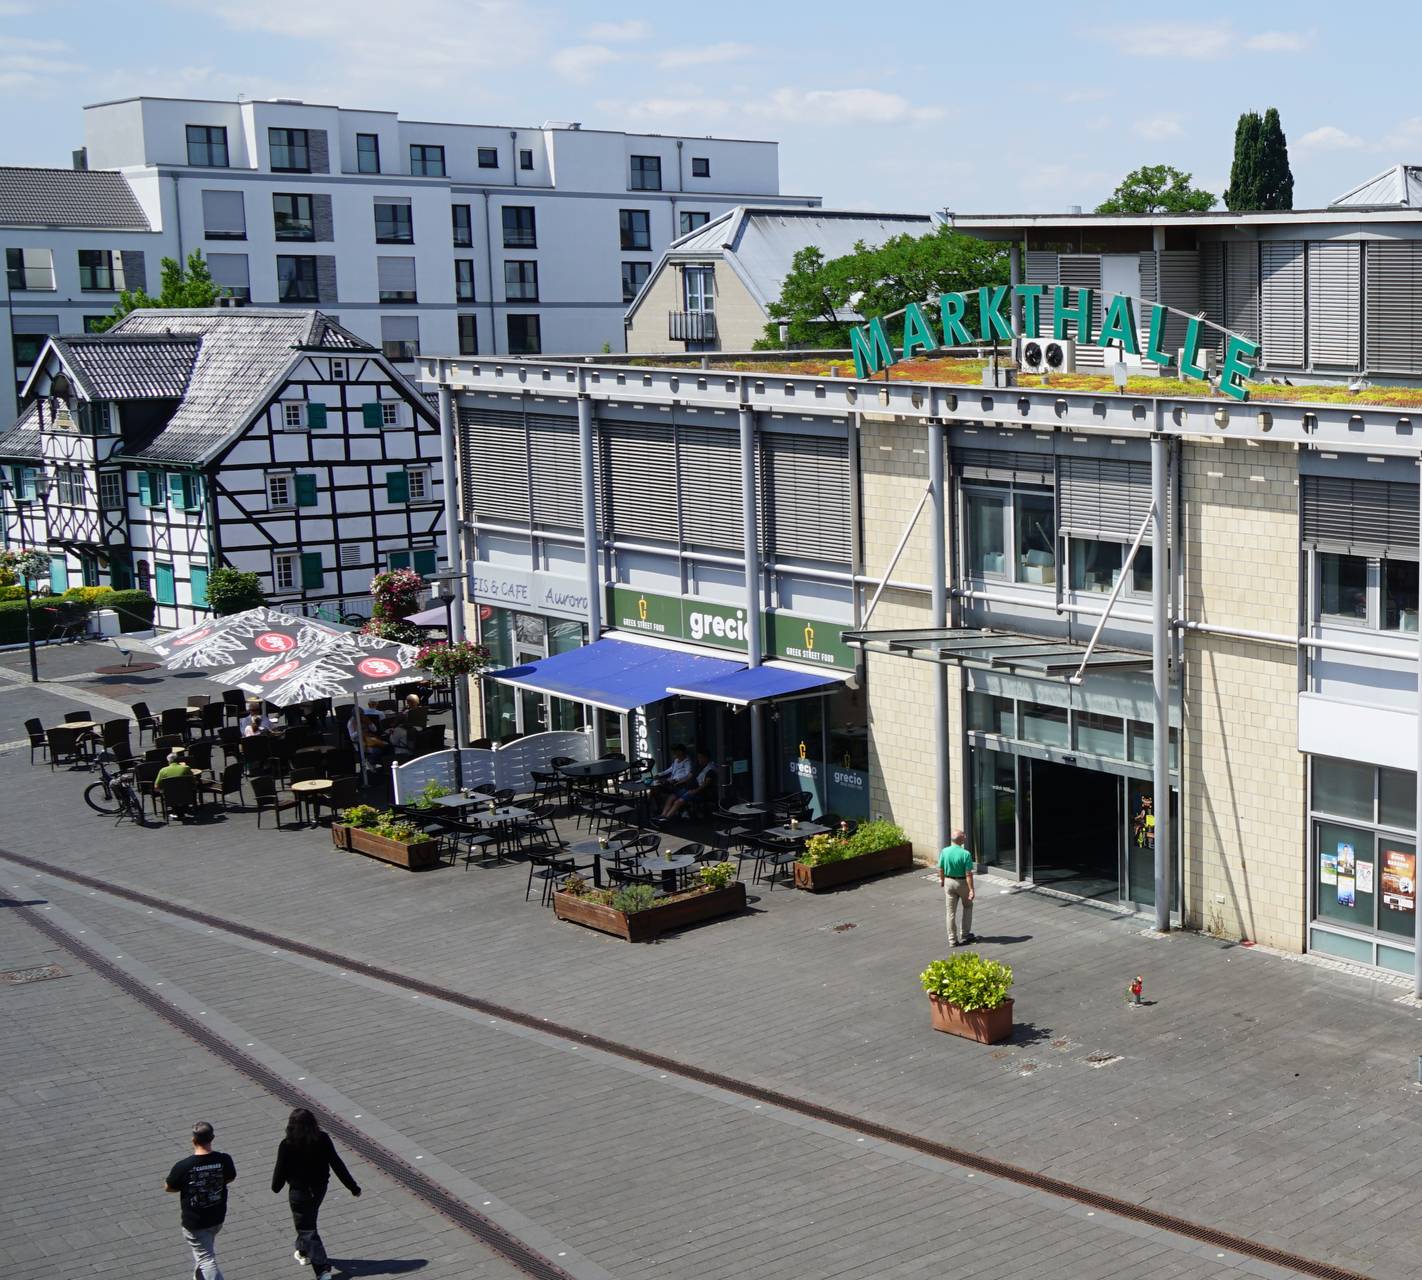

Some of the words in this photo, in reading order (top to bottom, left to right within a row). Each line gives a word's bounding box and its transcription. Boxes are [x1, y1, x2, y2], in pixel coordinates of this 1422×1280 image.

[849, 284, 1262, 402] MARKTHALLE
[473, 577, 489, 593] EIS
[802, 649, 820, 661] STREET
[834, 772, 863, 785] grecio
